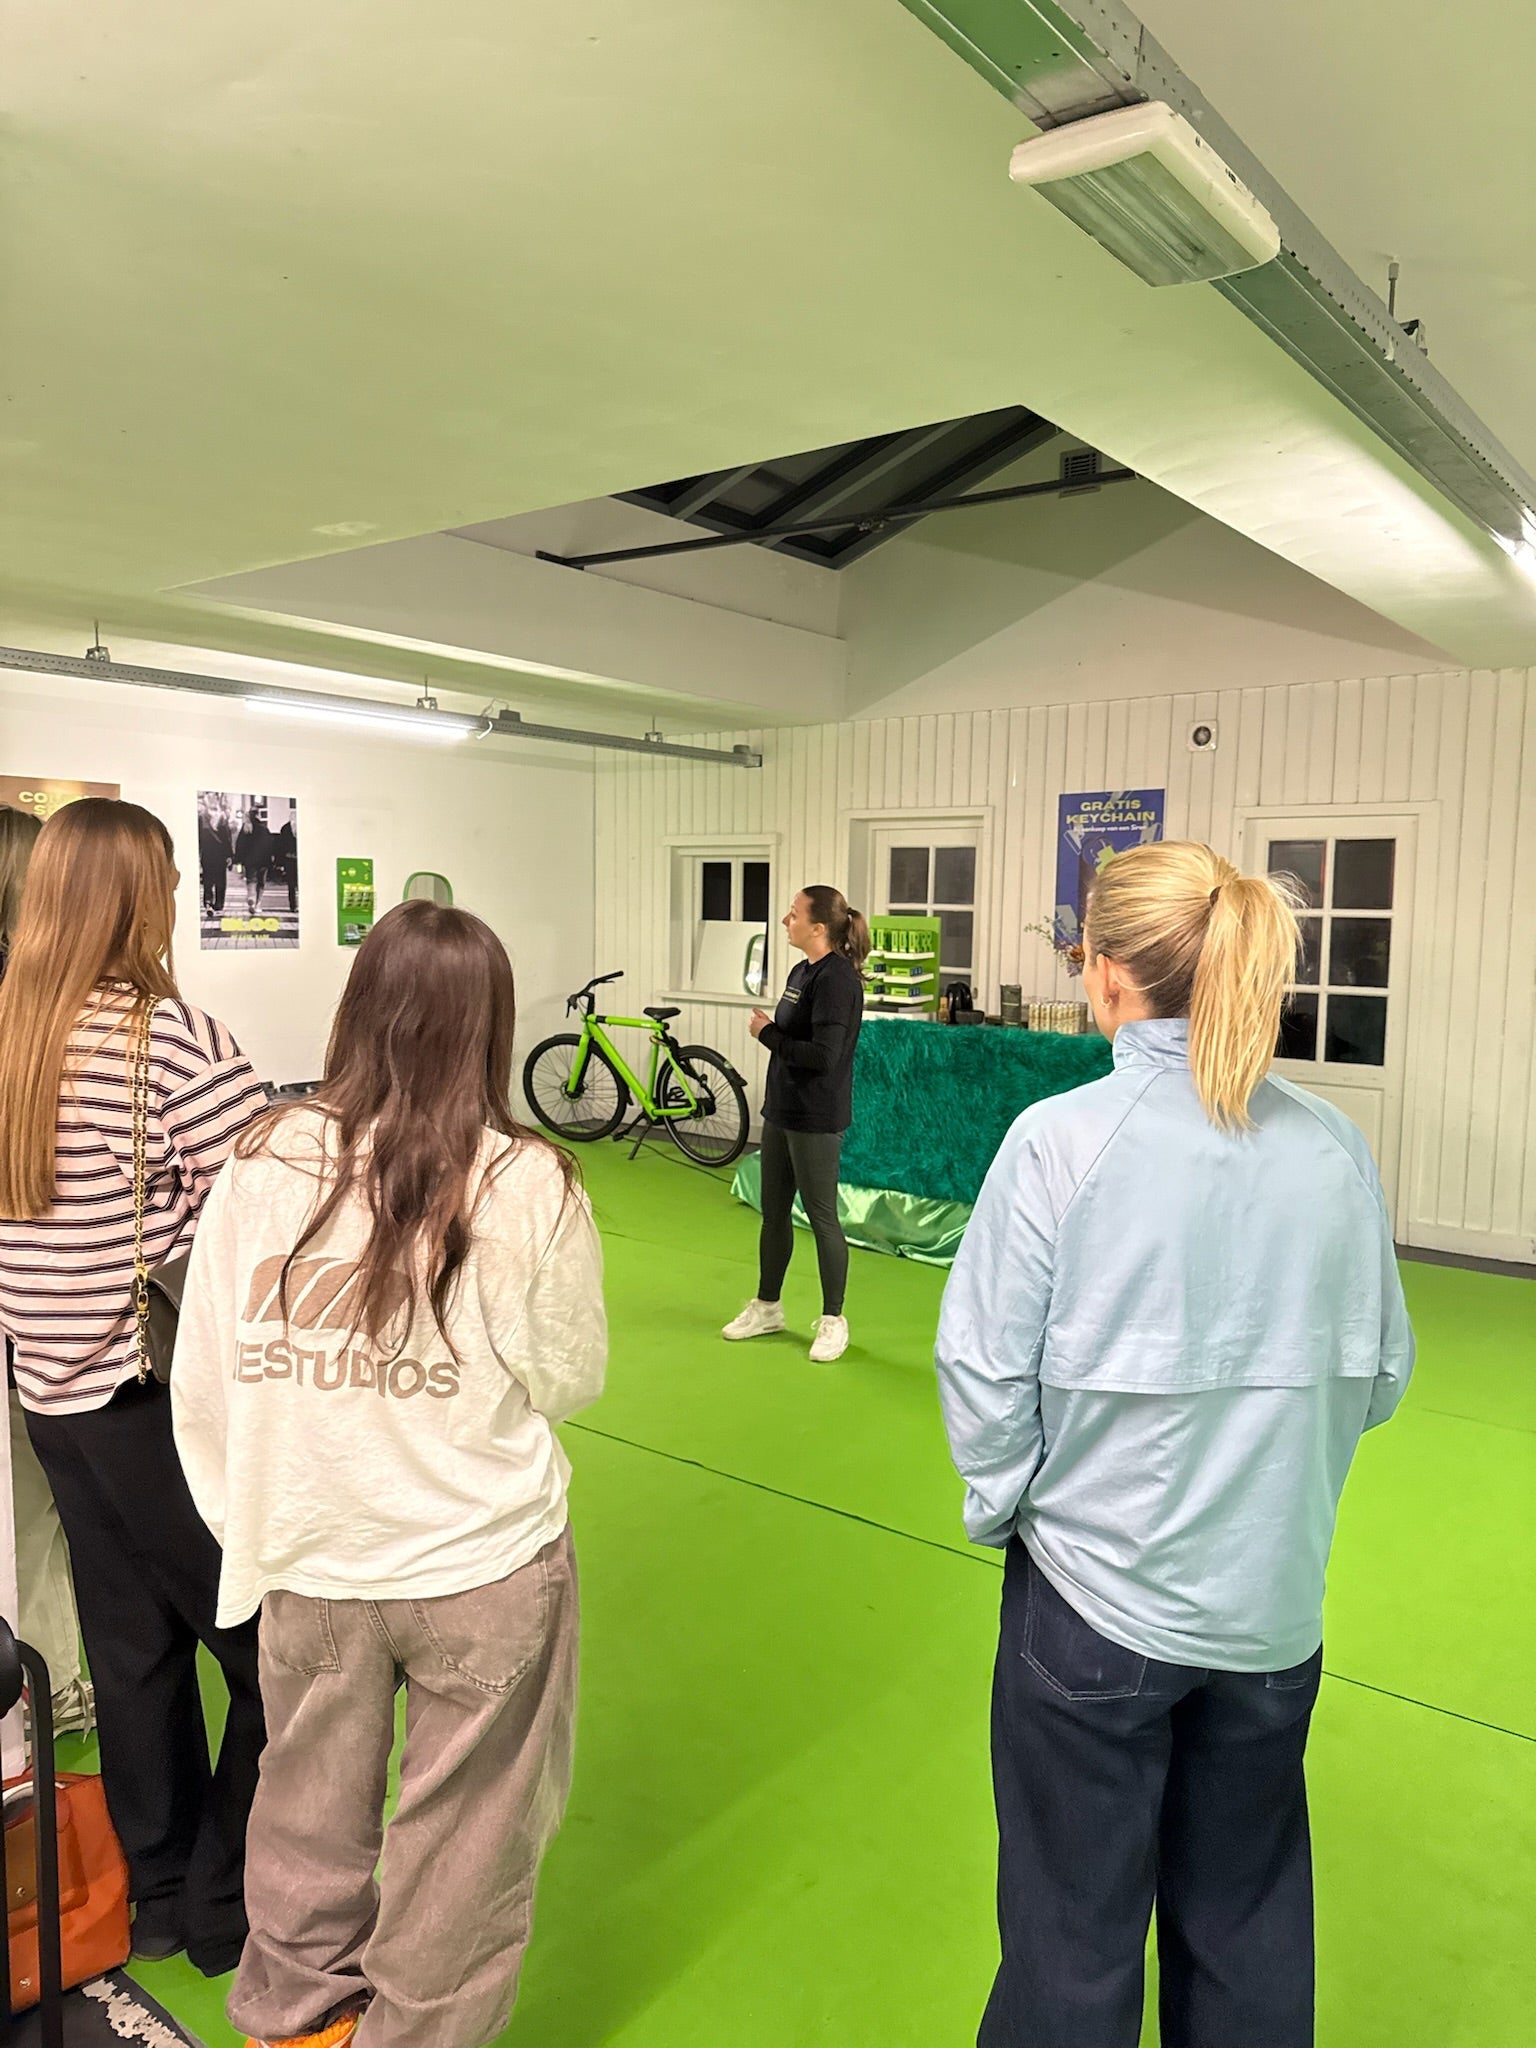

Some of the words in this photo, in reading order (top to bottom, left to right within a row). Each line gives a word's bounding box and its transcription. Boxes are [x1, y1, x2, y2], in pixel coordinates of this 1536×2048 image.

[1081, 800, 1141, 812] GRATIS
[1066, 811, 1155, 824] KEYCHAIN
[233, 1339, 460, 1399] ESTUDIOS
